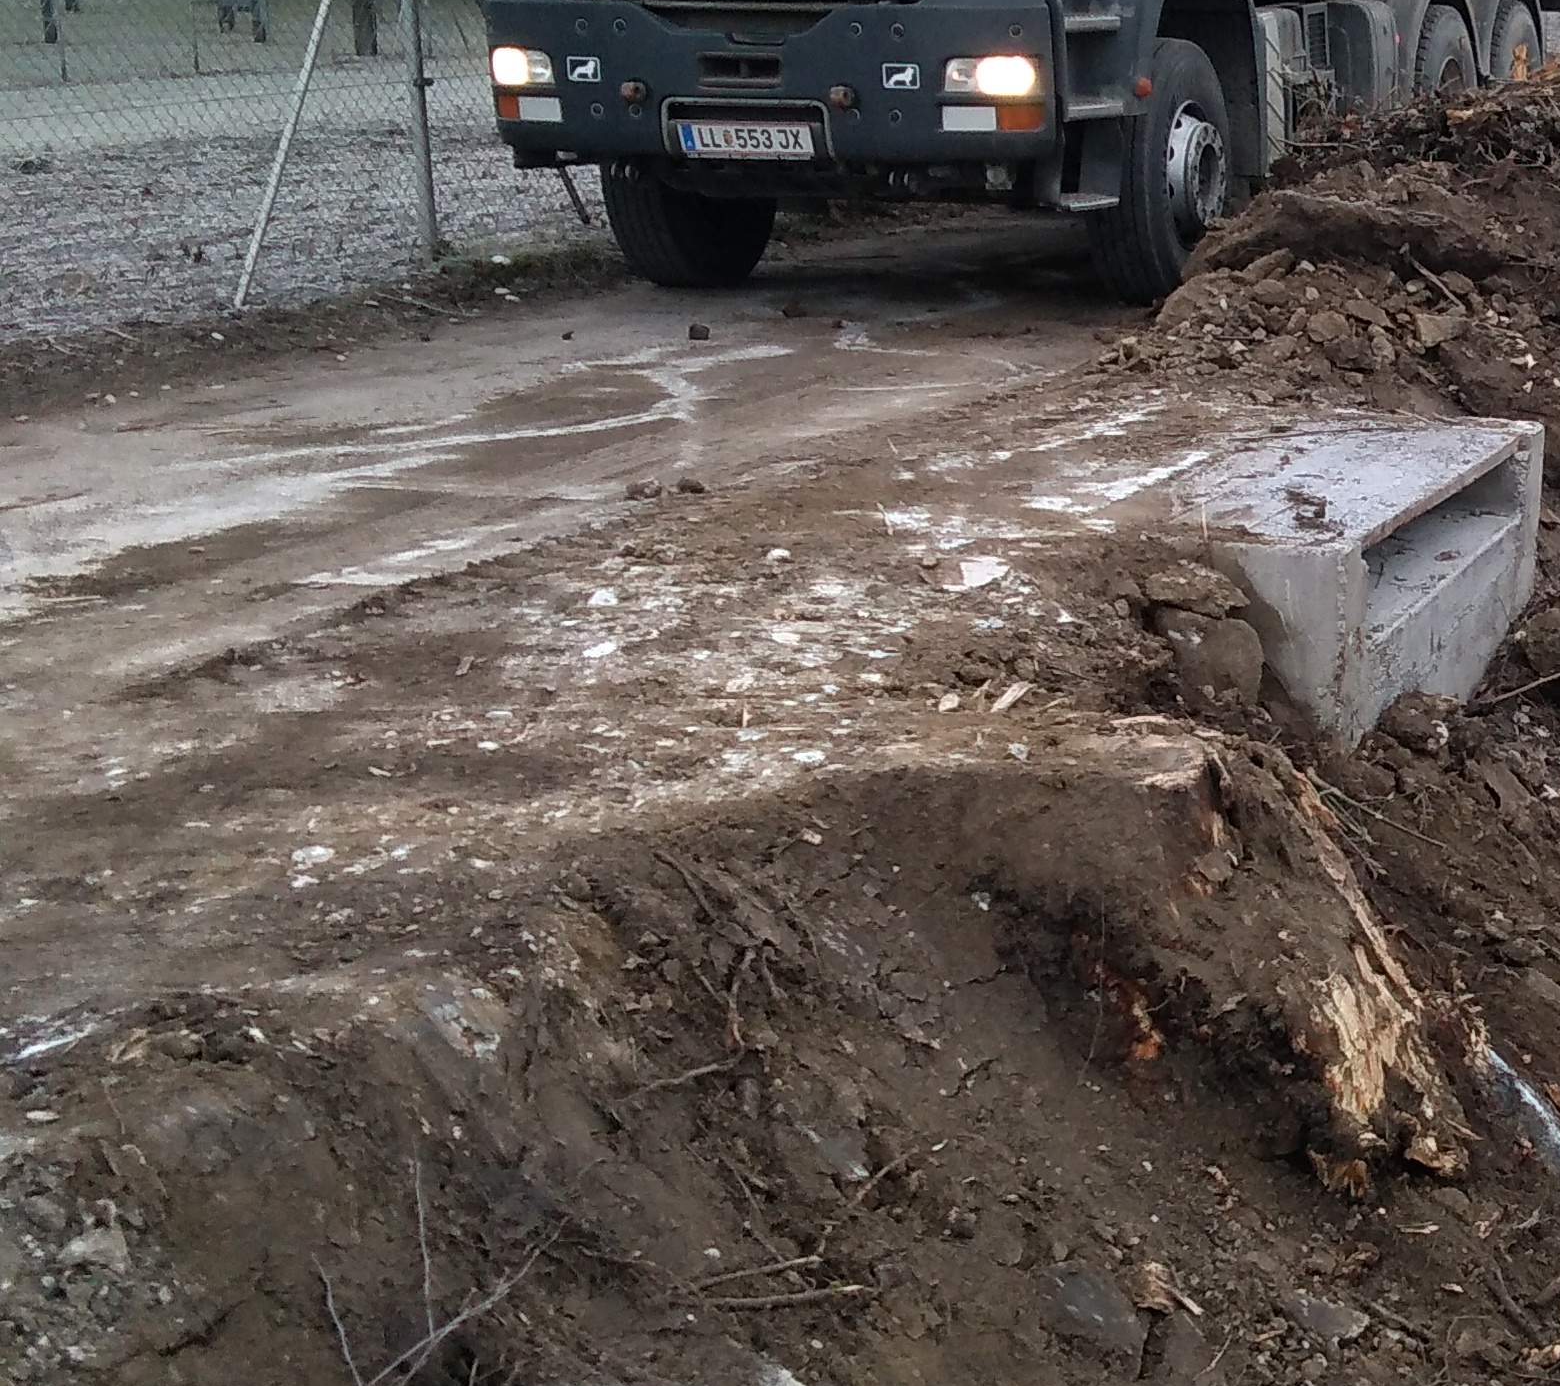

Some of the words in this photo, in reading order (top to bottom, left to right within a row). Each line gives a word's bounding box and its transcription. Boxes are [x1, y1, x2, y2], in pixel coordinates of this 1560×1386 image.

[697, 127, 723, 148] LL
[735, 128, 774, 150] 553
[776, 129, 804, 151] JX
